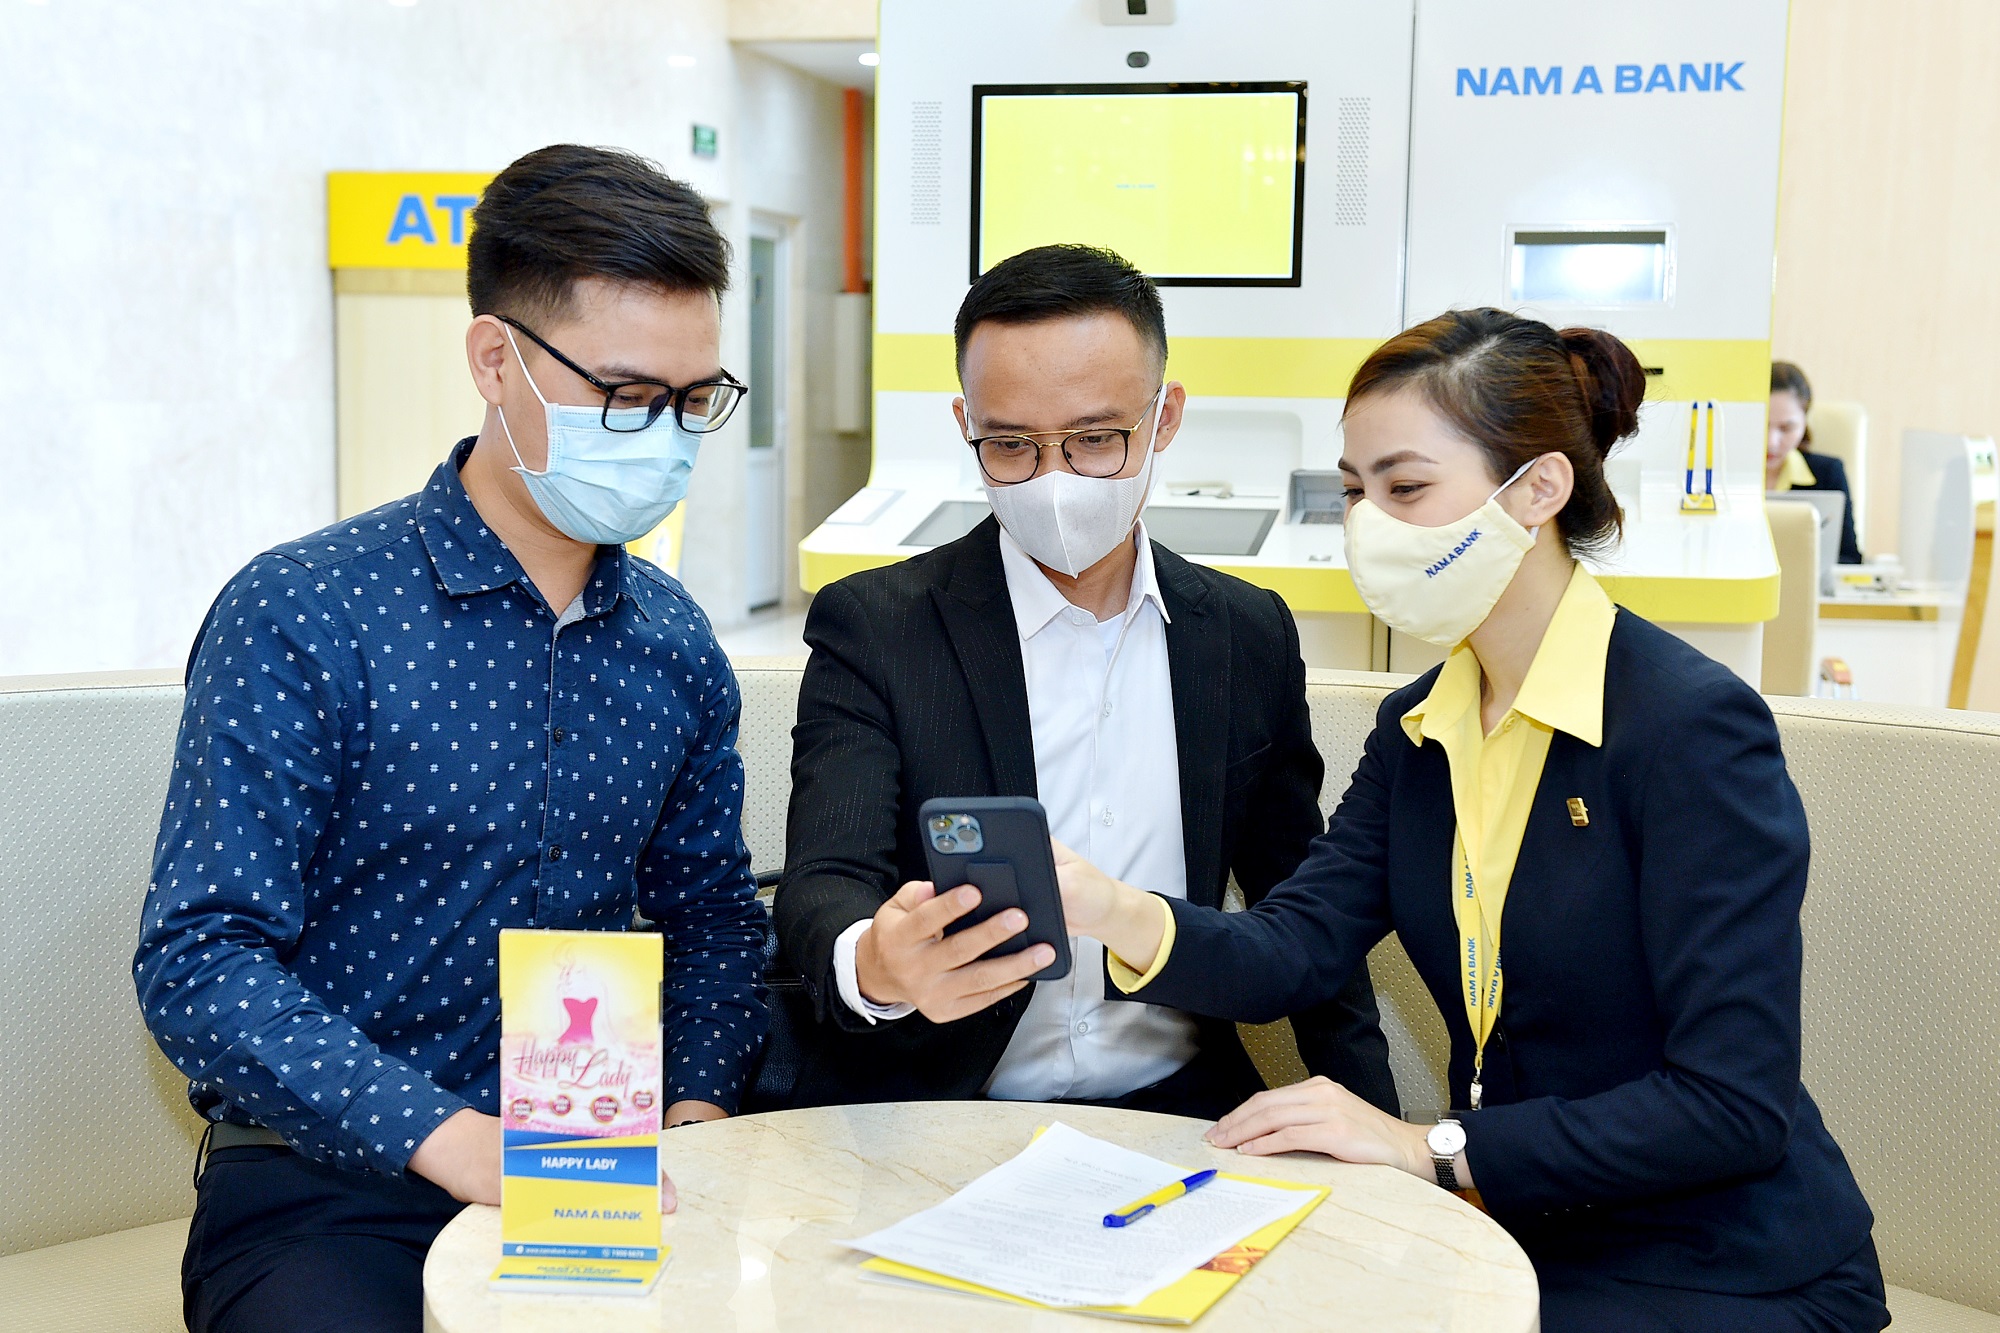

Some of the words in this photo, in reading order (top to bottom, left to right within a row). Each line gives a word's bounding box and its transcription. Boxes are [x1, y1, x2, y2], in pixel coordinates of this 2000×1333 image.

[1456, 66, 1563, 96] NAM
[1571, 65, 1604, 94] A
[1614, 62, 1746, 93] BANK
[387, 195, 478, 244] AT
[1424, 557, 1451, 578] NAM
[1447, 552, 1459, 562] A
[1453, 528, 1482, 556] BANK
[1467, 937, 1476, 968] BANK
[1468, 970, 1476, 978] A
[1468, 980, 1477, 1007] NAM
[1487, 979, 1499, 1010] BANK
[512, 1037, 581, 1082] Happy
[558, 1049, 633, 1100] Lady
[541, 1156, 584, 1170] HAPPY
[585, 1157, 618, 1171] LADY
[554, 1208, 588, 1220] NAM
[590, 1209, 600, 1220] A
[602, 1209, 643, 1222] BANK
